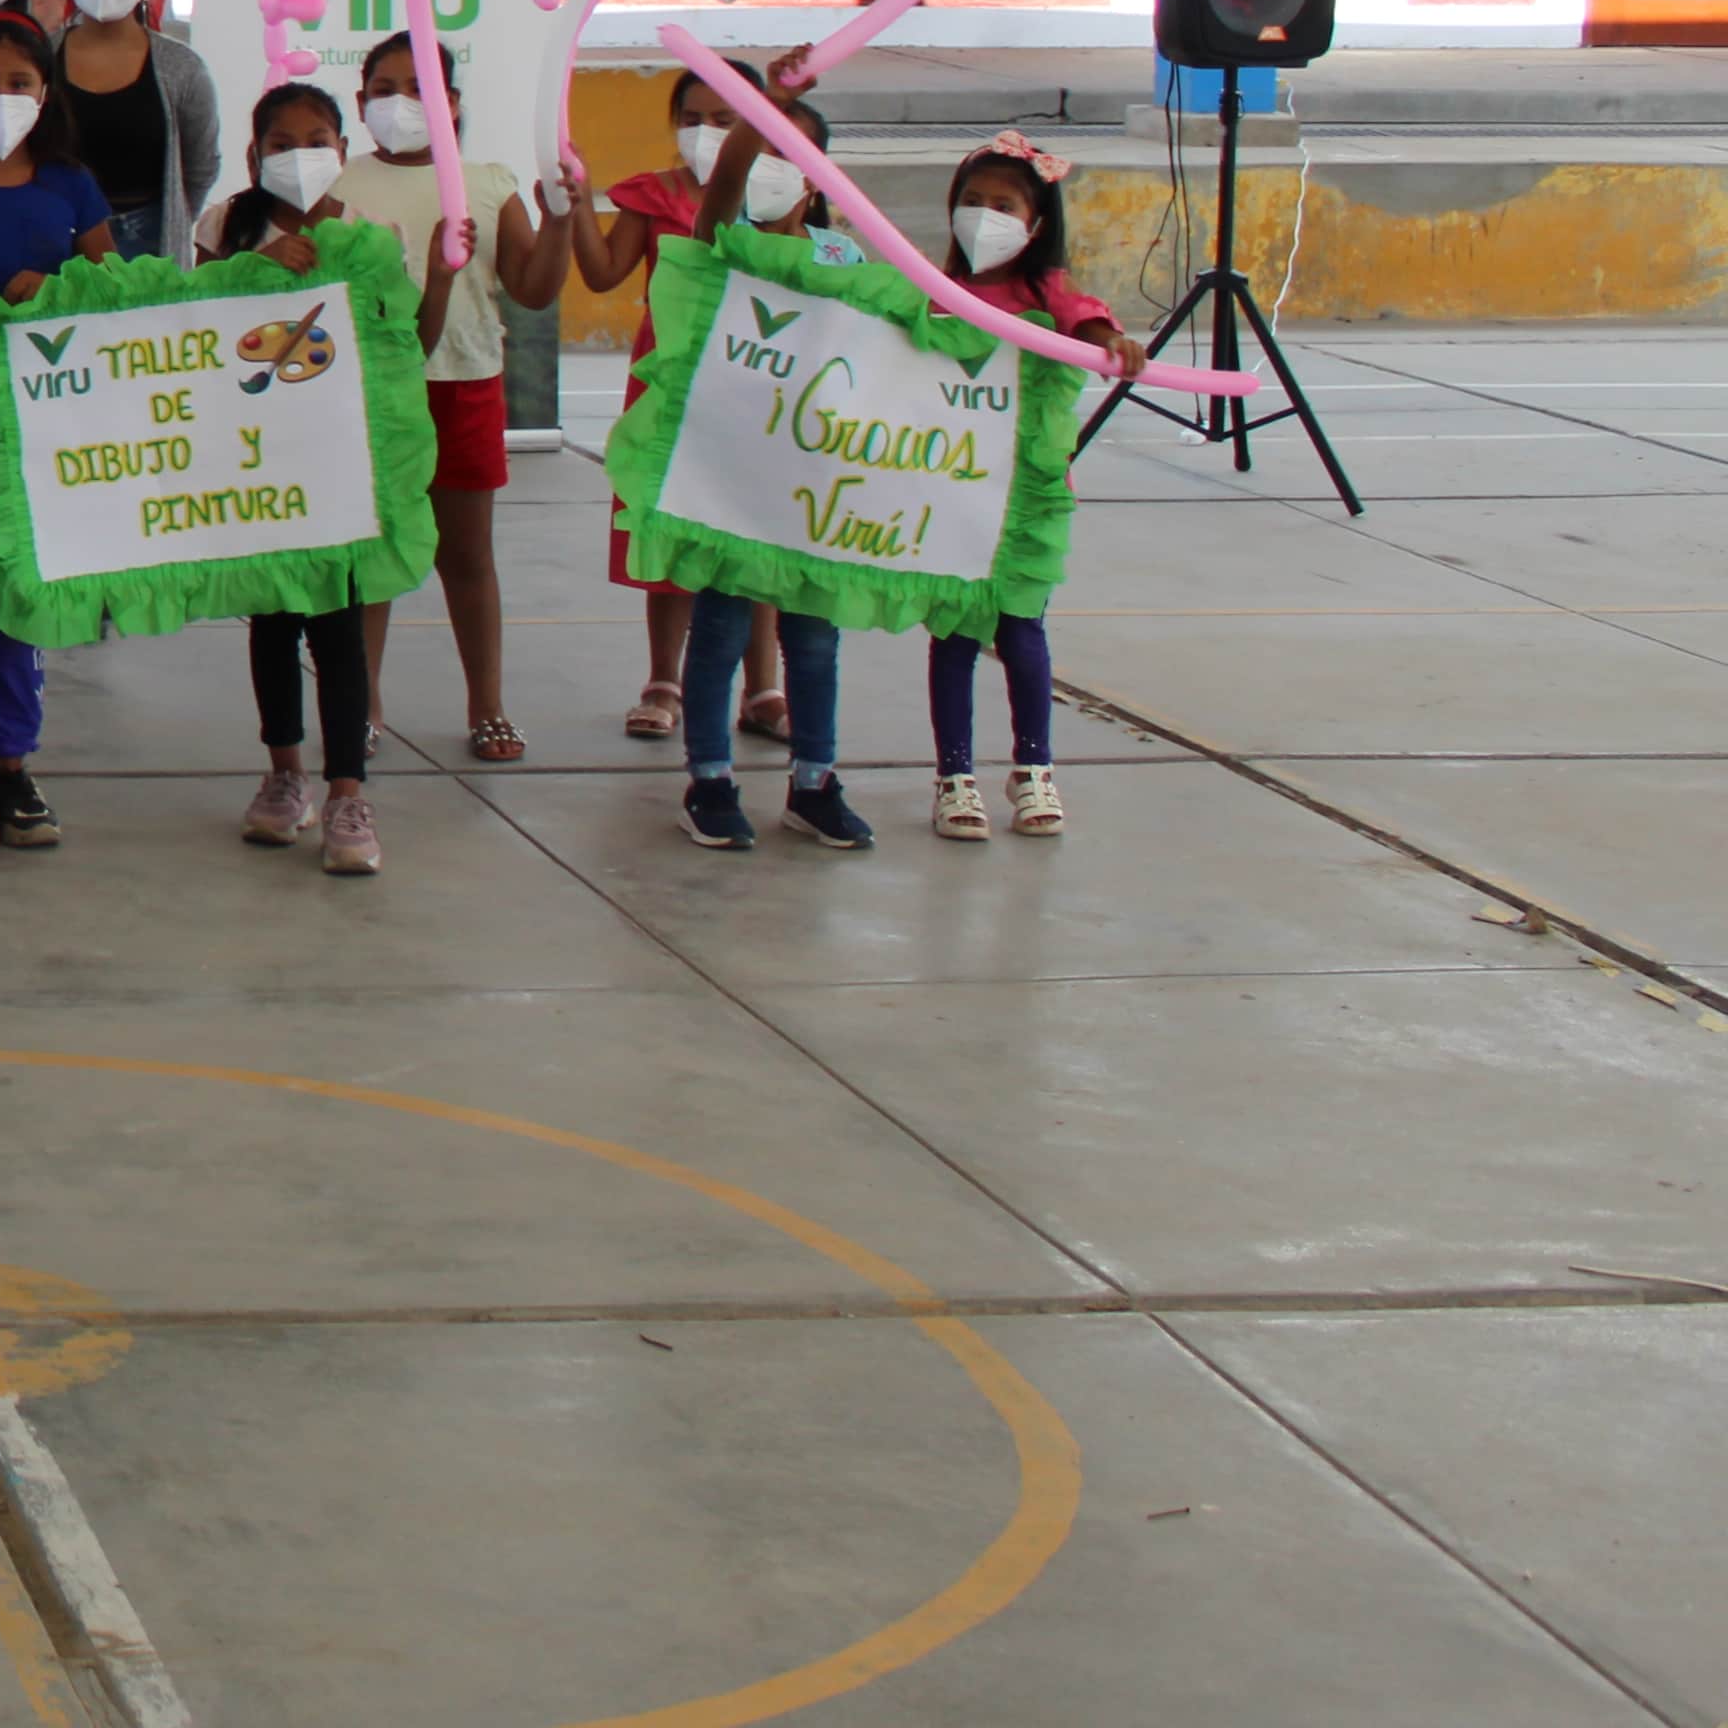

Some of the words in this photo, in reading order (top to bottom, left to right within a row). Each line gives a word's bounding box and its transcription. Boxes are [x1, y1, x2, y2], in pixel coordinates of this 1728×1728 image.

[96, 328, 225, 382] TALLER
[151, 390, 195, 424] DE
[55, 435, 194, 487] DIBUJO
[141, 485, 308, 538] PINTURA
